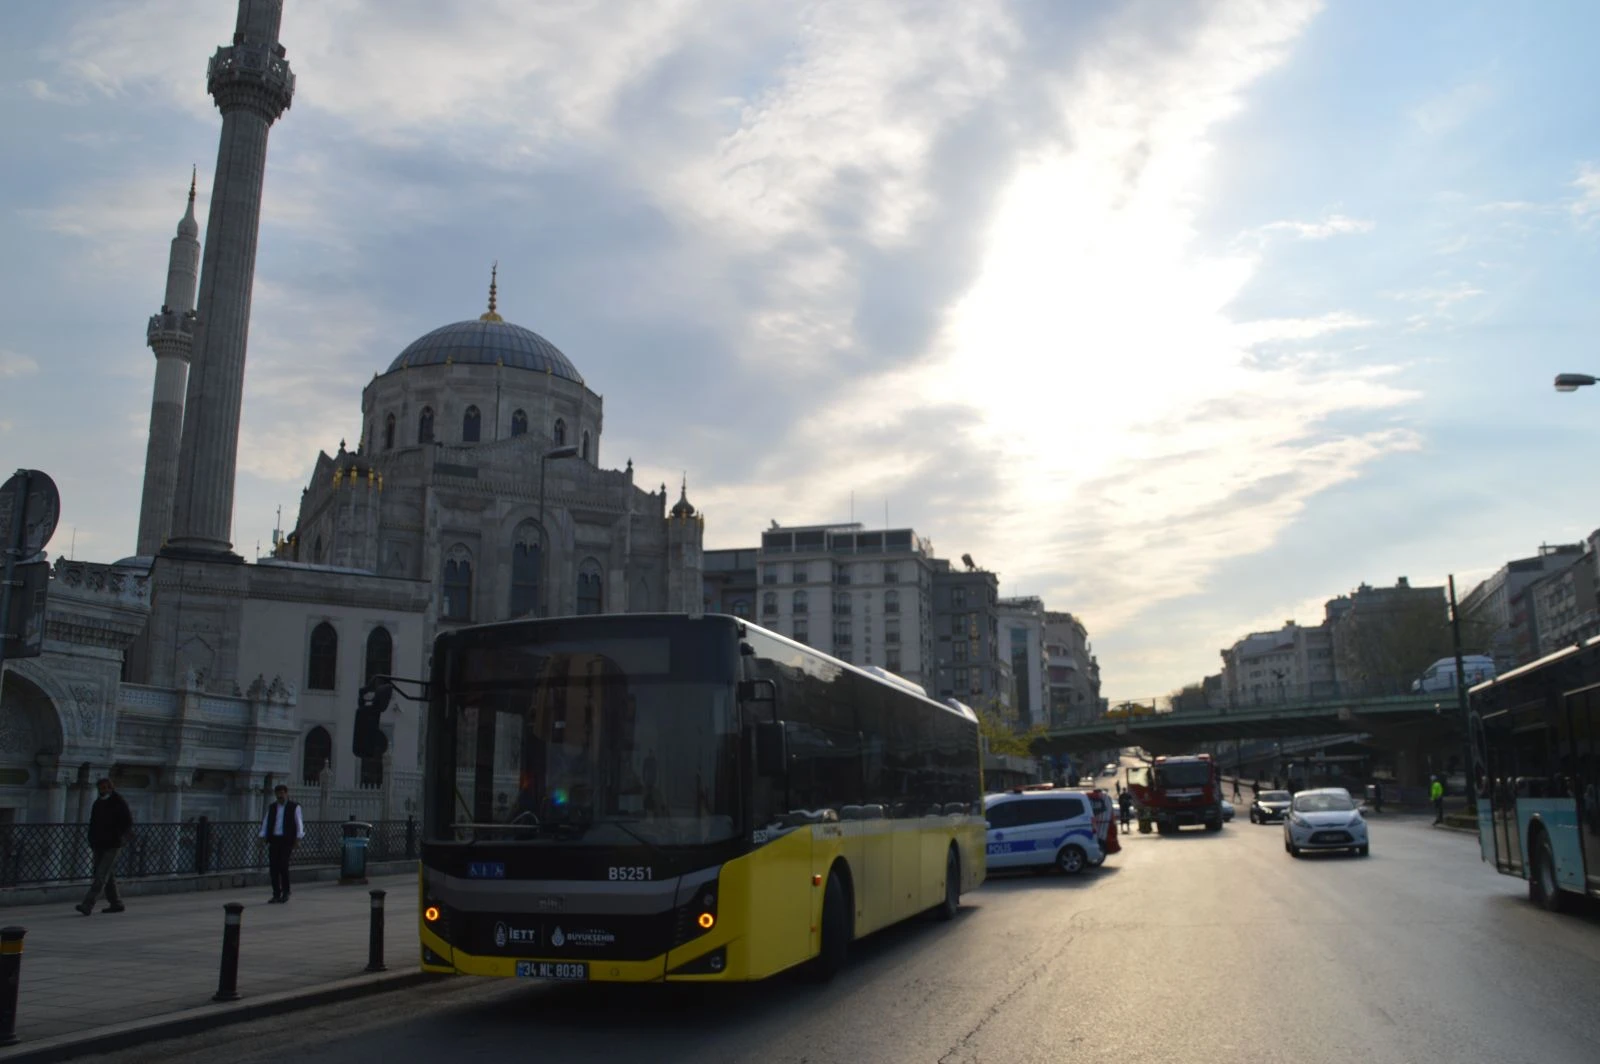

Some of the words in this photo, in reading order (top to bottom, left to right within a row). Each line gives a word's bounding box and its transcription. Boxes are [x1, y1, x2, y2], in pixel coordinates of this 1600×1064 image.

[608, 866, 652, 881] B5251
[524, 962, 537, 976] 34
[556, 964, 584, 978] 8038
